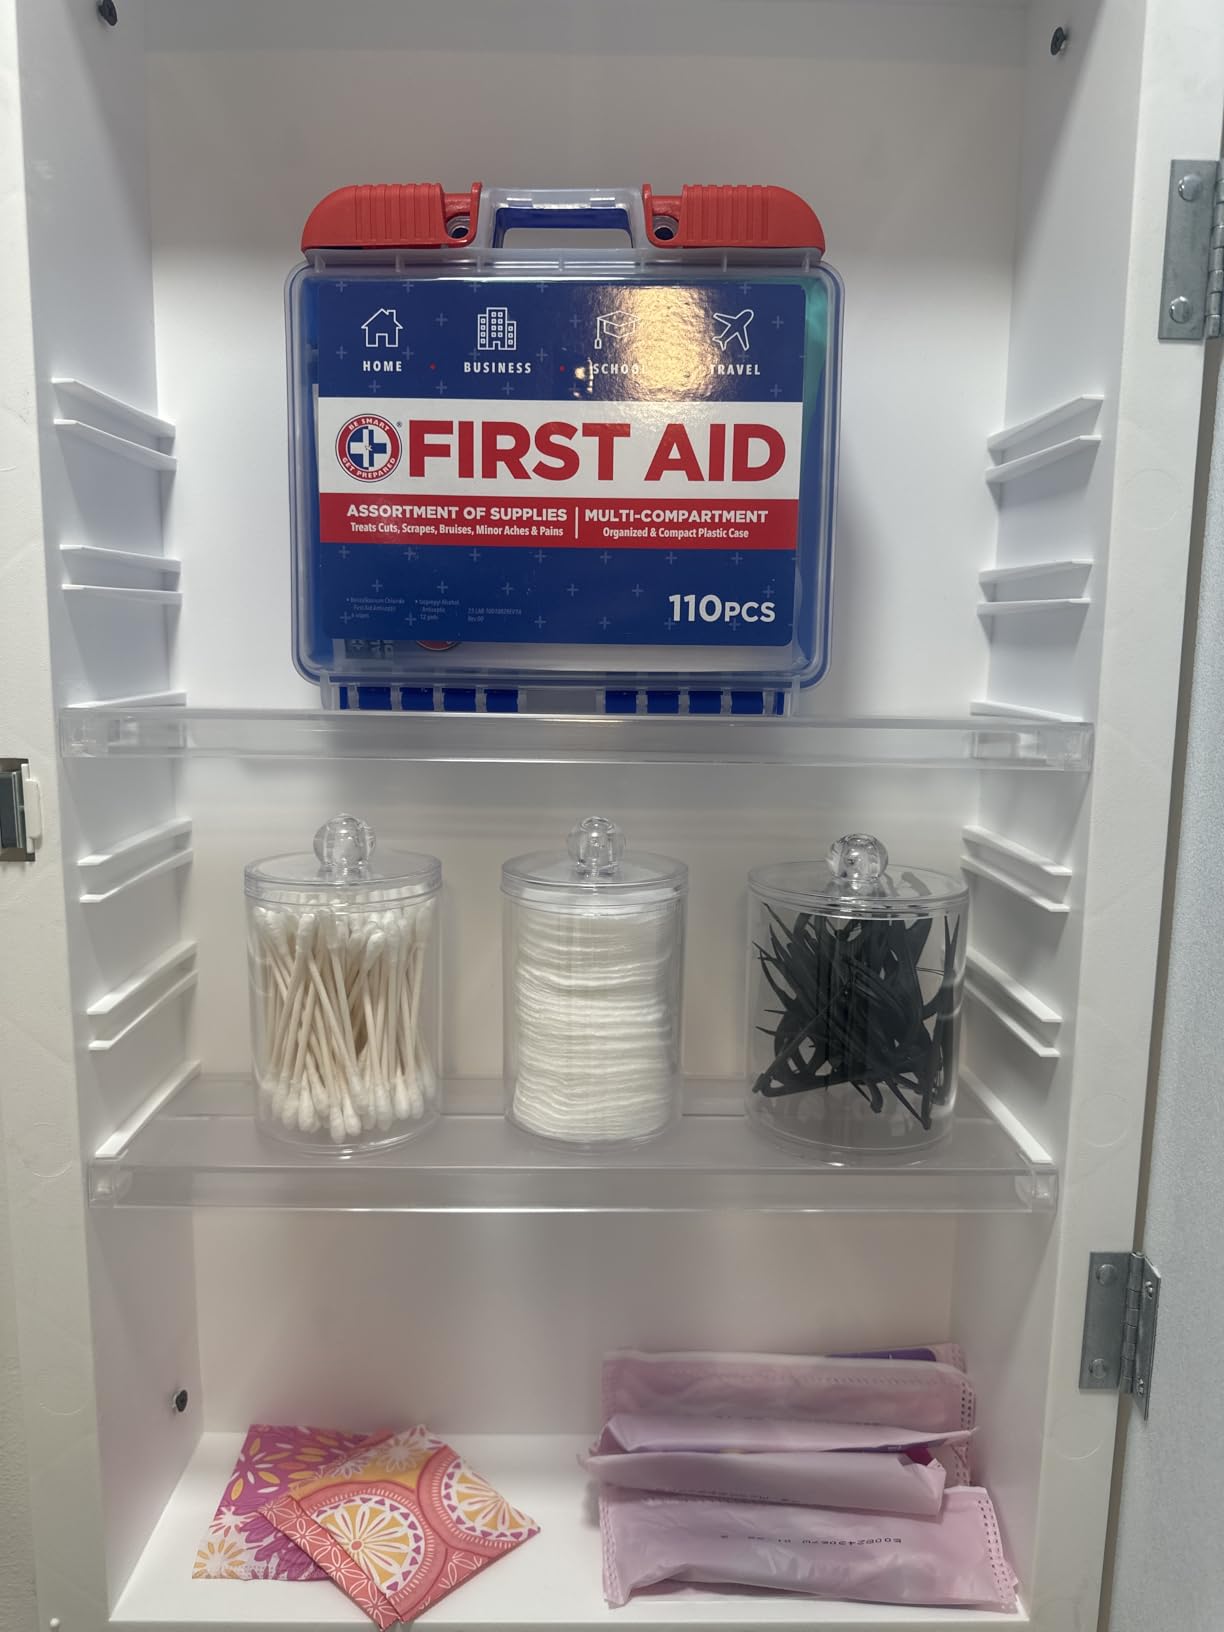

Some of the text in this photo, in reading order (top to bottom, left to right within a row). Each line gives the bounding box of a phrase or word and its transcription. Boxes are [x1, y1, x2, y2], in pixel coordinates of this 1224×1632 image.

[362, 360, 403, 373] HOME
[463, 361, 532, 374] BUSINESS
[710, 363, 761, 376] TRAVEL
[348, 418, 390, 431] BE SMART
[409, 419, 786, 482] FIRST AID
[342, 457, 396, 478] GET PREPARED
[346, 504, 568, 522] ASSORTMENT OF SUPPLIES
[584, 509, 769, 524] MULTI-COMPARTMENT
[351, 522, 564, 537] Treats Cuts, Scrapes, Bruises, Minor Aches & Pains
[603, 527, 749, 540] Organized & Compact Plastic Case
[668, 594, 776, 623] 110PCS
